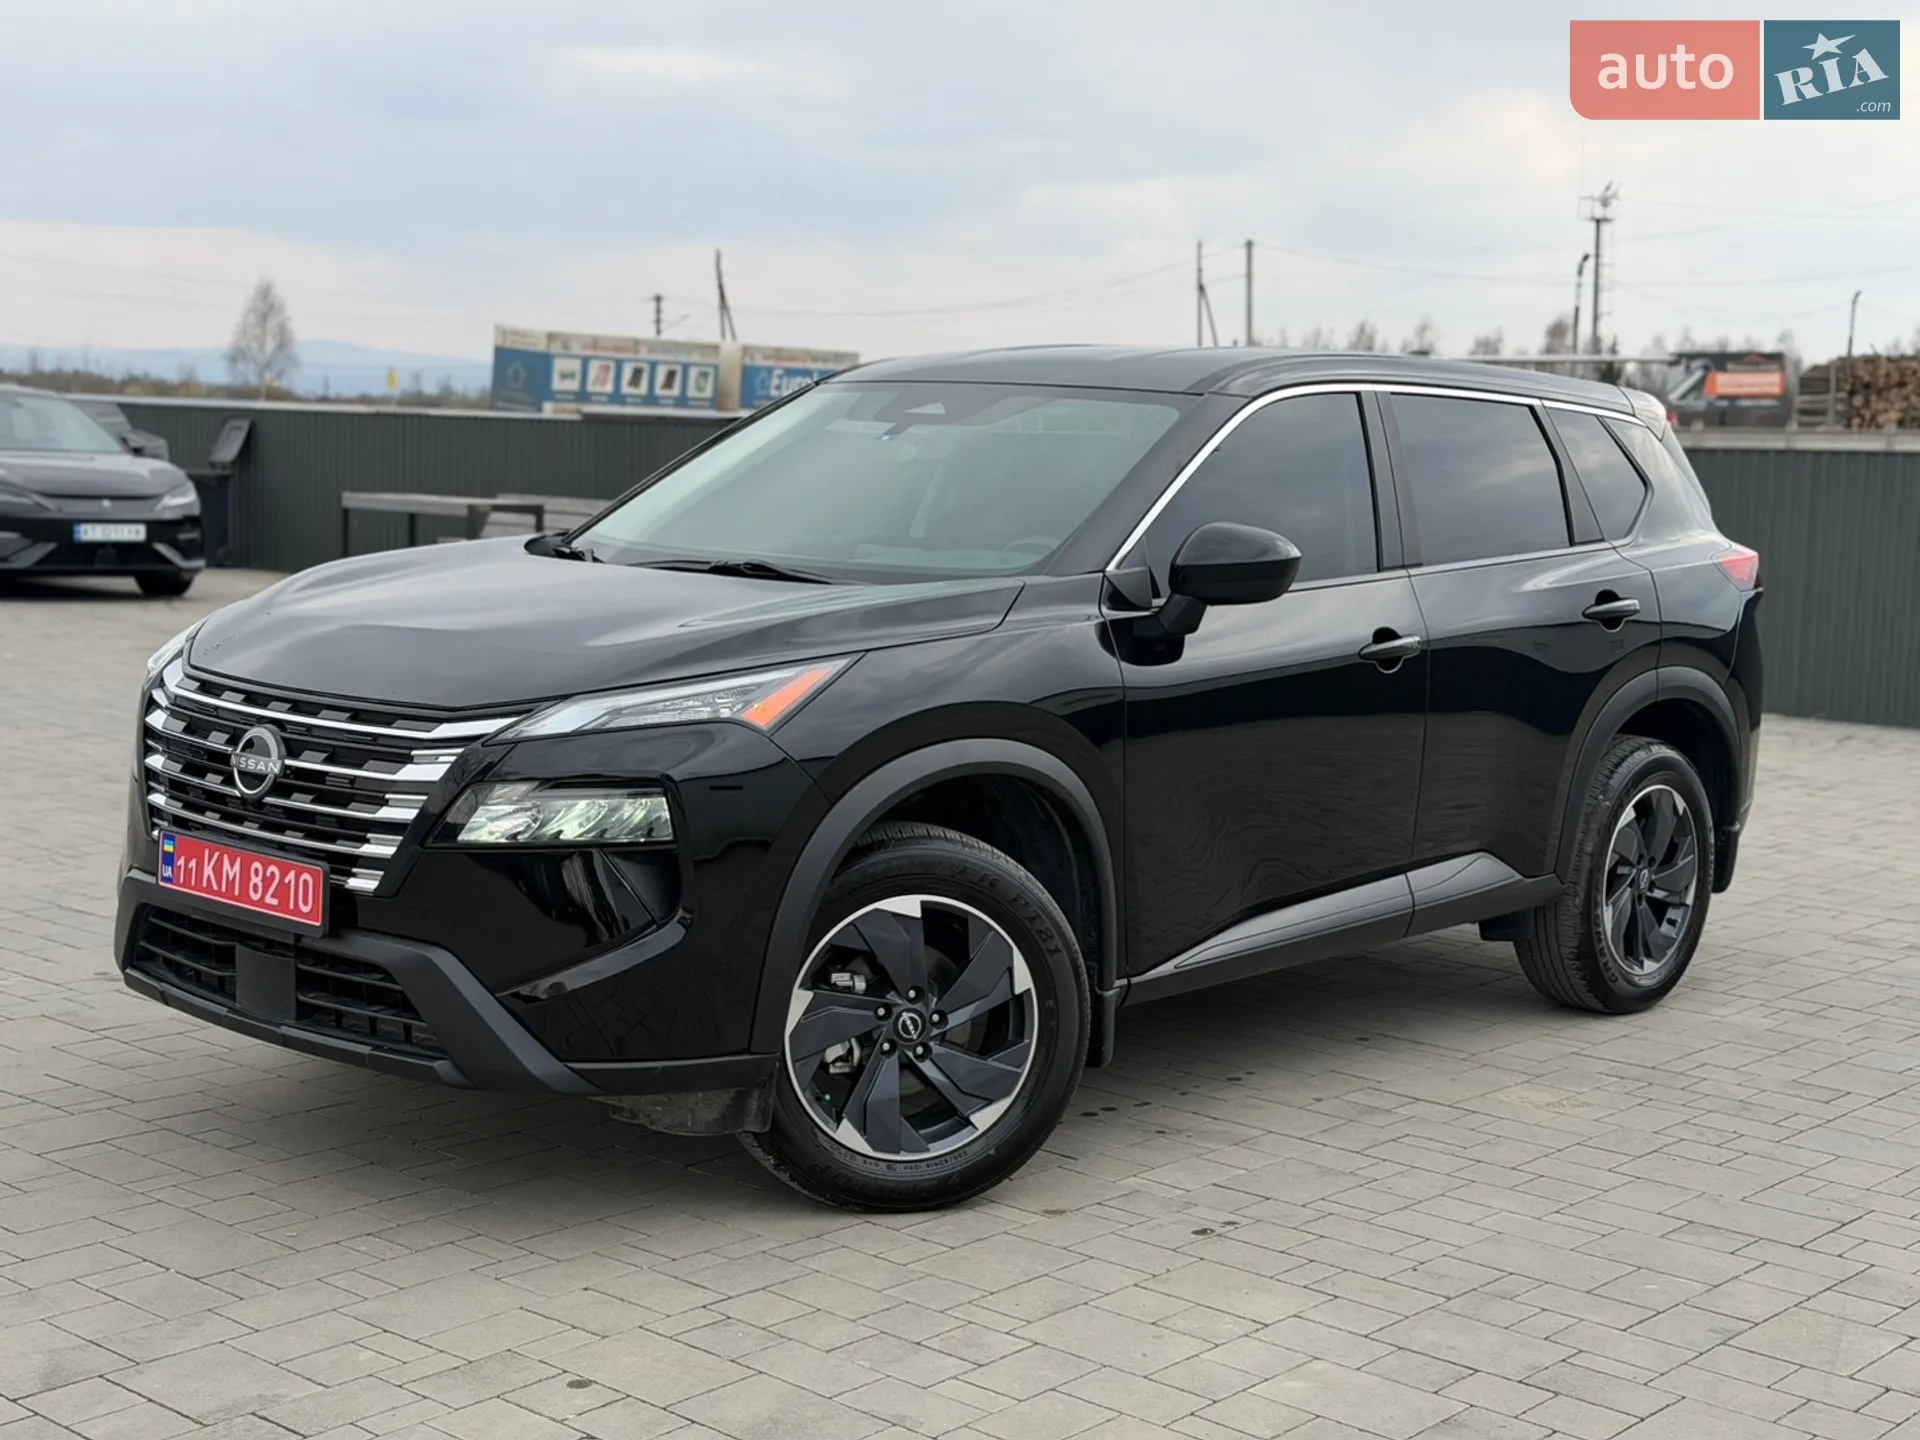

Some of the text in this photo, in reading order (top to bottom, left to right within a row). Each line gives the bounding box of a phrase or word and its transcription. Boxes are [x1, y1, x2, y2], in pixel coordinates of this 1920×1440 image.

[231, 753, 282, 774] NISSAN
[162, 865, 173, 879] UA
[249, 861, 314, 914] 8210
